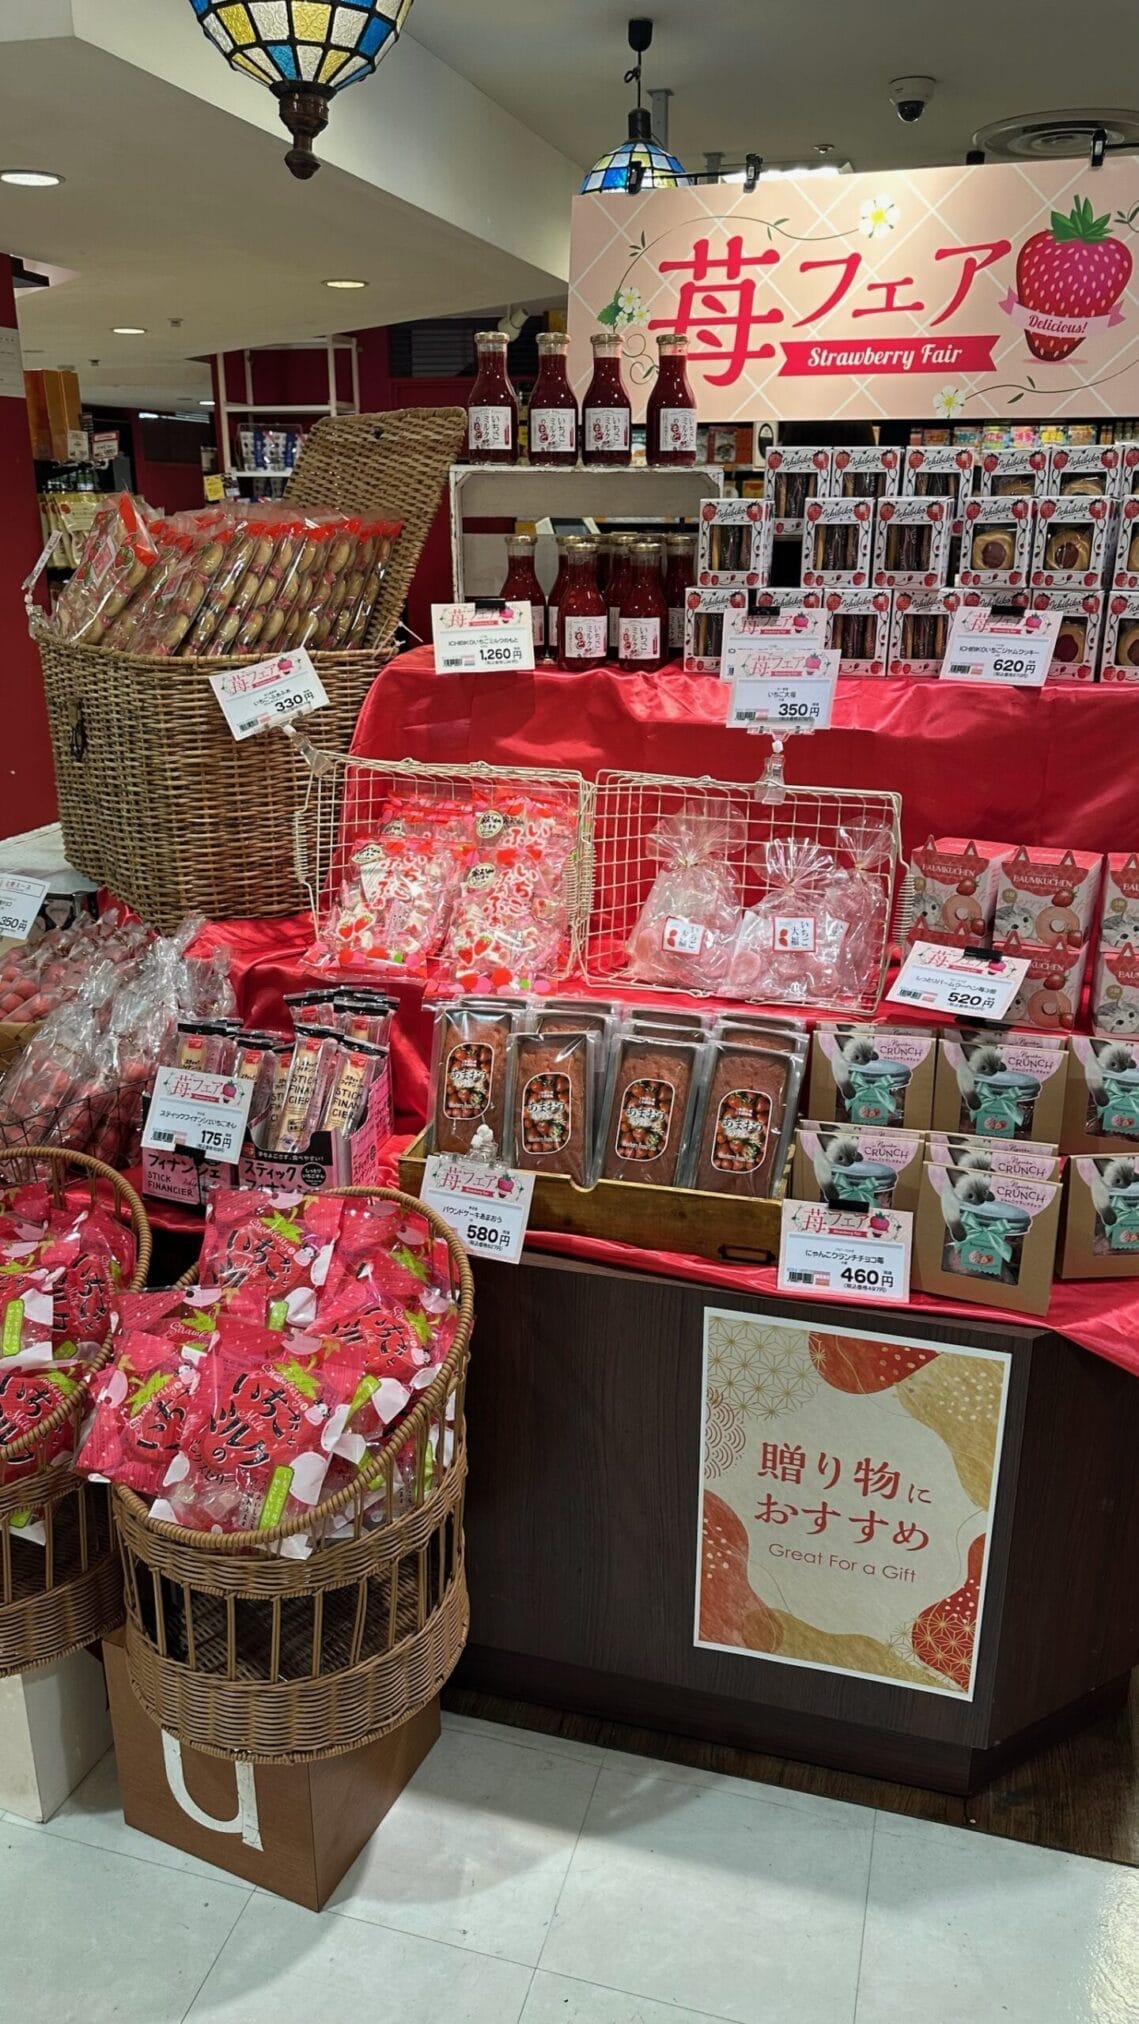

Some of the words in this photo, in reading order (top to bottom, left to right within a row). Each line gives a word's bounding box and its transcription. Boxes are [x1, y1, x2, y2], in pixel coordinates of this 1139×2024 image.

[648, 235, 1012, 387] 苺フェア
[1027, 313, 1088, 336] Delicious!
[807, 346, 914, 370] Strawberry
[921, 344, 963, 366] Fair
[752, 655, 805, 677] 苺フェア
[232, 663, 276, 695] 苺フェア
[921, 863, 976, 878] BAUMKUCHEN
[1013, 875, 1073, 888] BAUMKUCHEN
[790, 926, 799, 946] 大福
[800, 920, 809, 947] いちご
[880, 1045, 923, 1057] CRUNCH
[1007, 1056, 1054, 1069] CRUNCH
[170, 1074, 224, 1098] 苺フェア
[864, 1146, 909, 1159] CRUNCH
[148, 1171, 172, 1183] STICK
[244, 1160, 297, 1181] スティック
[440, 1166, 497, 1191] 苺フェア
[997, 1162, 1046, 1177] CRUNCH
[148, 1181, 194, 1197] FINANCIER
[996, 1186, 1047, 1203] CRUNCH
[802, 1208, 869, 1233] 苺フェア
[466, 1224, 511, 1247] 580円
[840, 1267, 894, 1288] 460円
[261, 1362, 302, 1407] Strawberry
[237, 1408, 267, 1433] Milk
[757, 1441, 932, 1505] 贈り物に
[753, 1492, 931, 1552] おすすめ
[768, 1542, 824, 1568] Great
[828, 1553, 858, 1573] For
[863, 1561, 876, 1575] a
[882, 1564, 917, 1584] Gift
